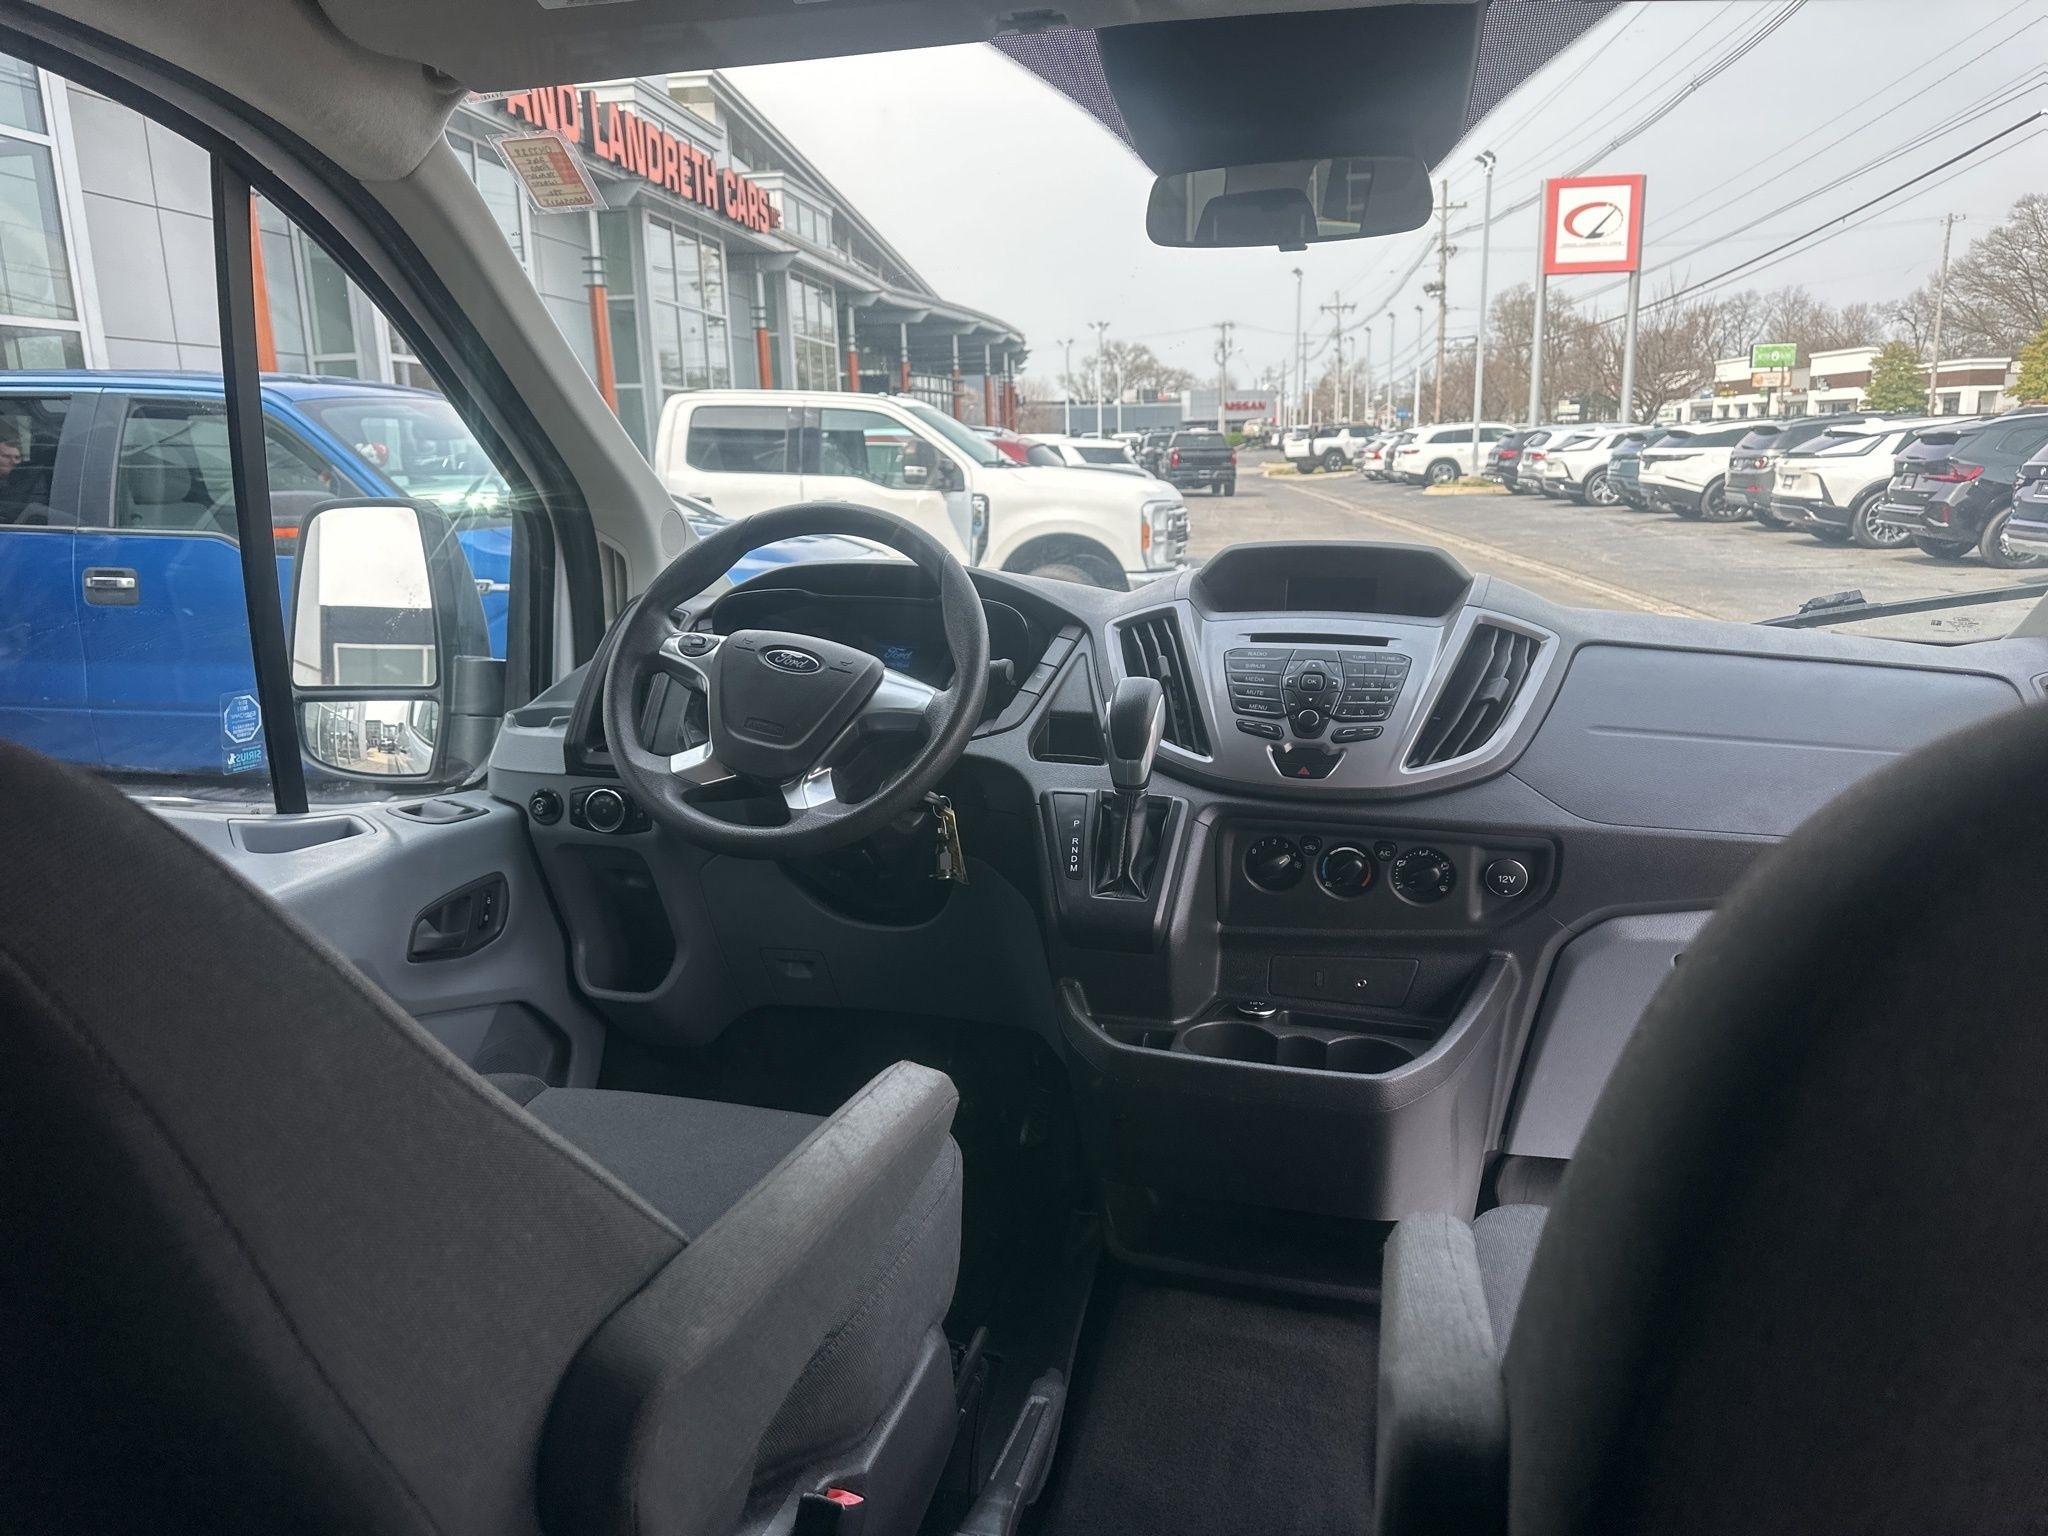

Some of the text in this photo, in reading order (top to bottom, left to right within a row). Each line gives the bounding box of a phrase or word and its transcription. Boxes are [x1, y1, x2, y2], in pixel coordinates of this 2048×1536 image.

[590, 90, 719, 211] LANDRETH
[723, 168, 769, 233] CARS
[1224, 401, 1266, 411] NISSAN
[775, 652, 809, 668] Ford
[1248, 703, 1268, 711] MENU
[1073, 819, 1080, 828] P
[1071, 837, 1079, 845] R
[1071, 846, 1079, 854] N
[1070, 855, 1078, 863] D
[1069, 864, 1078, 872] M
[1497, 875, 1516, 884] 12V
